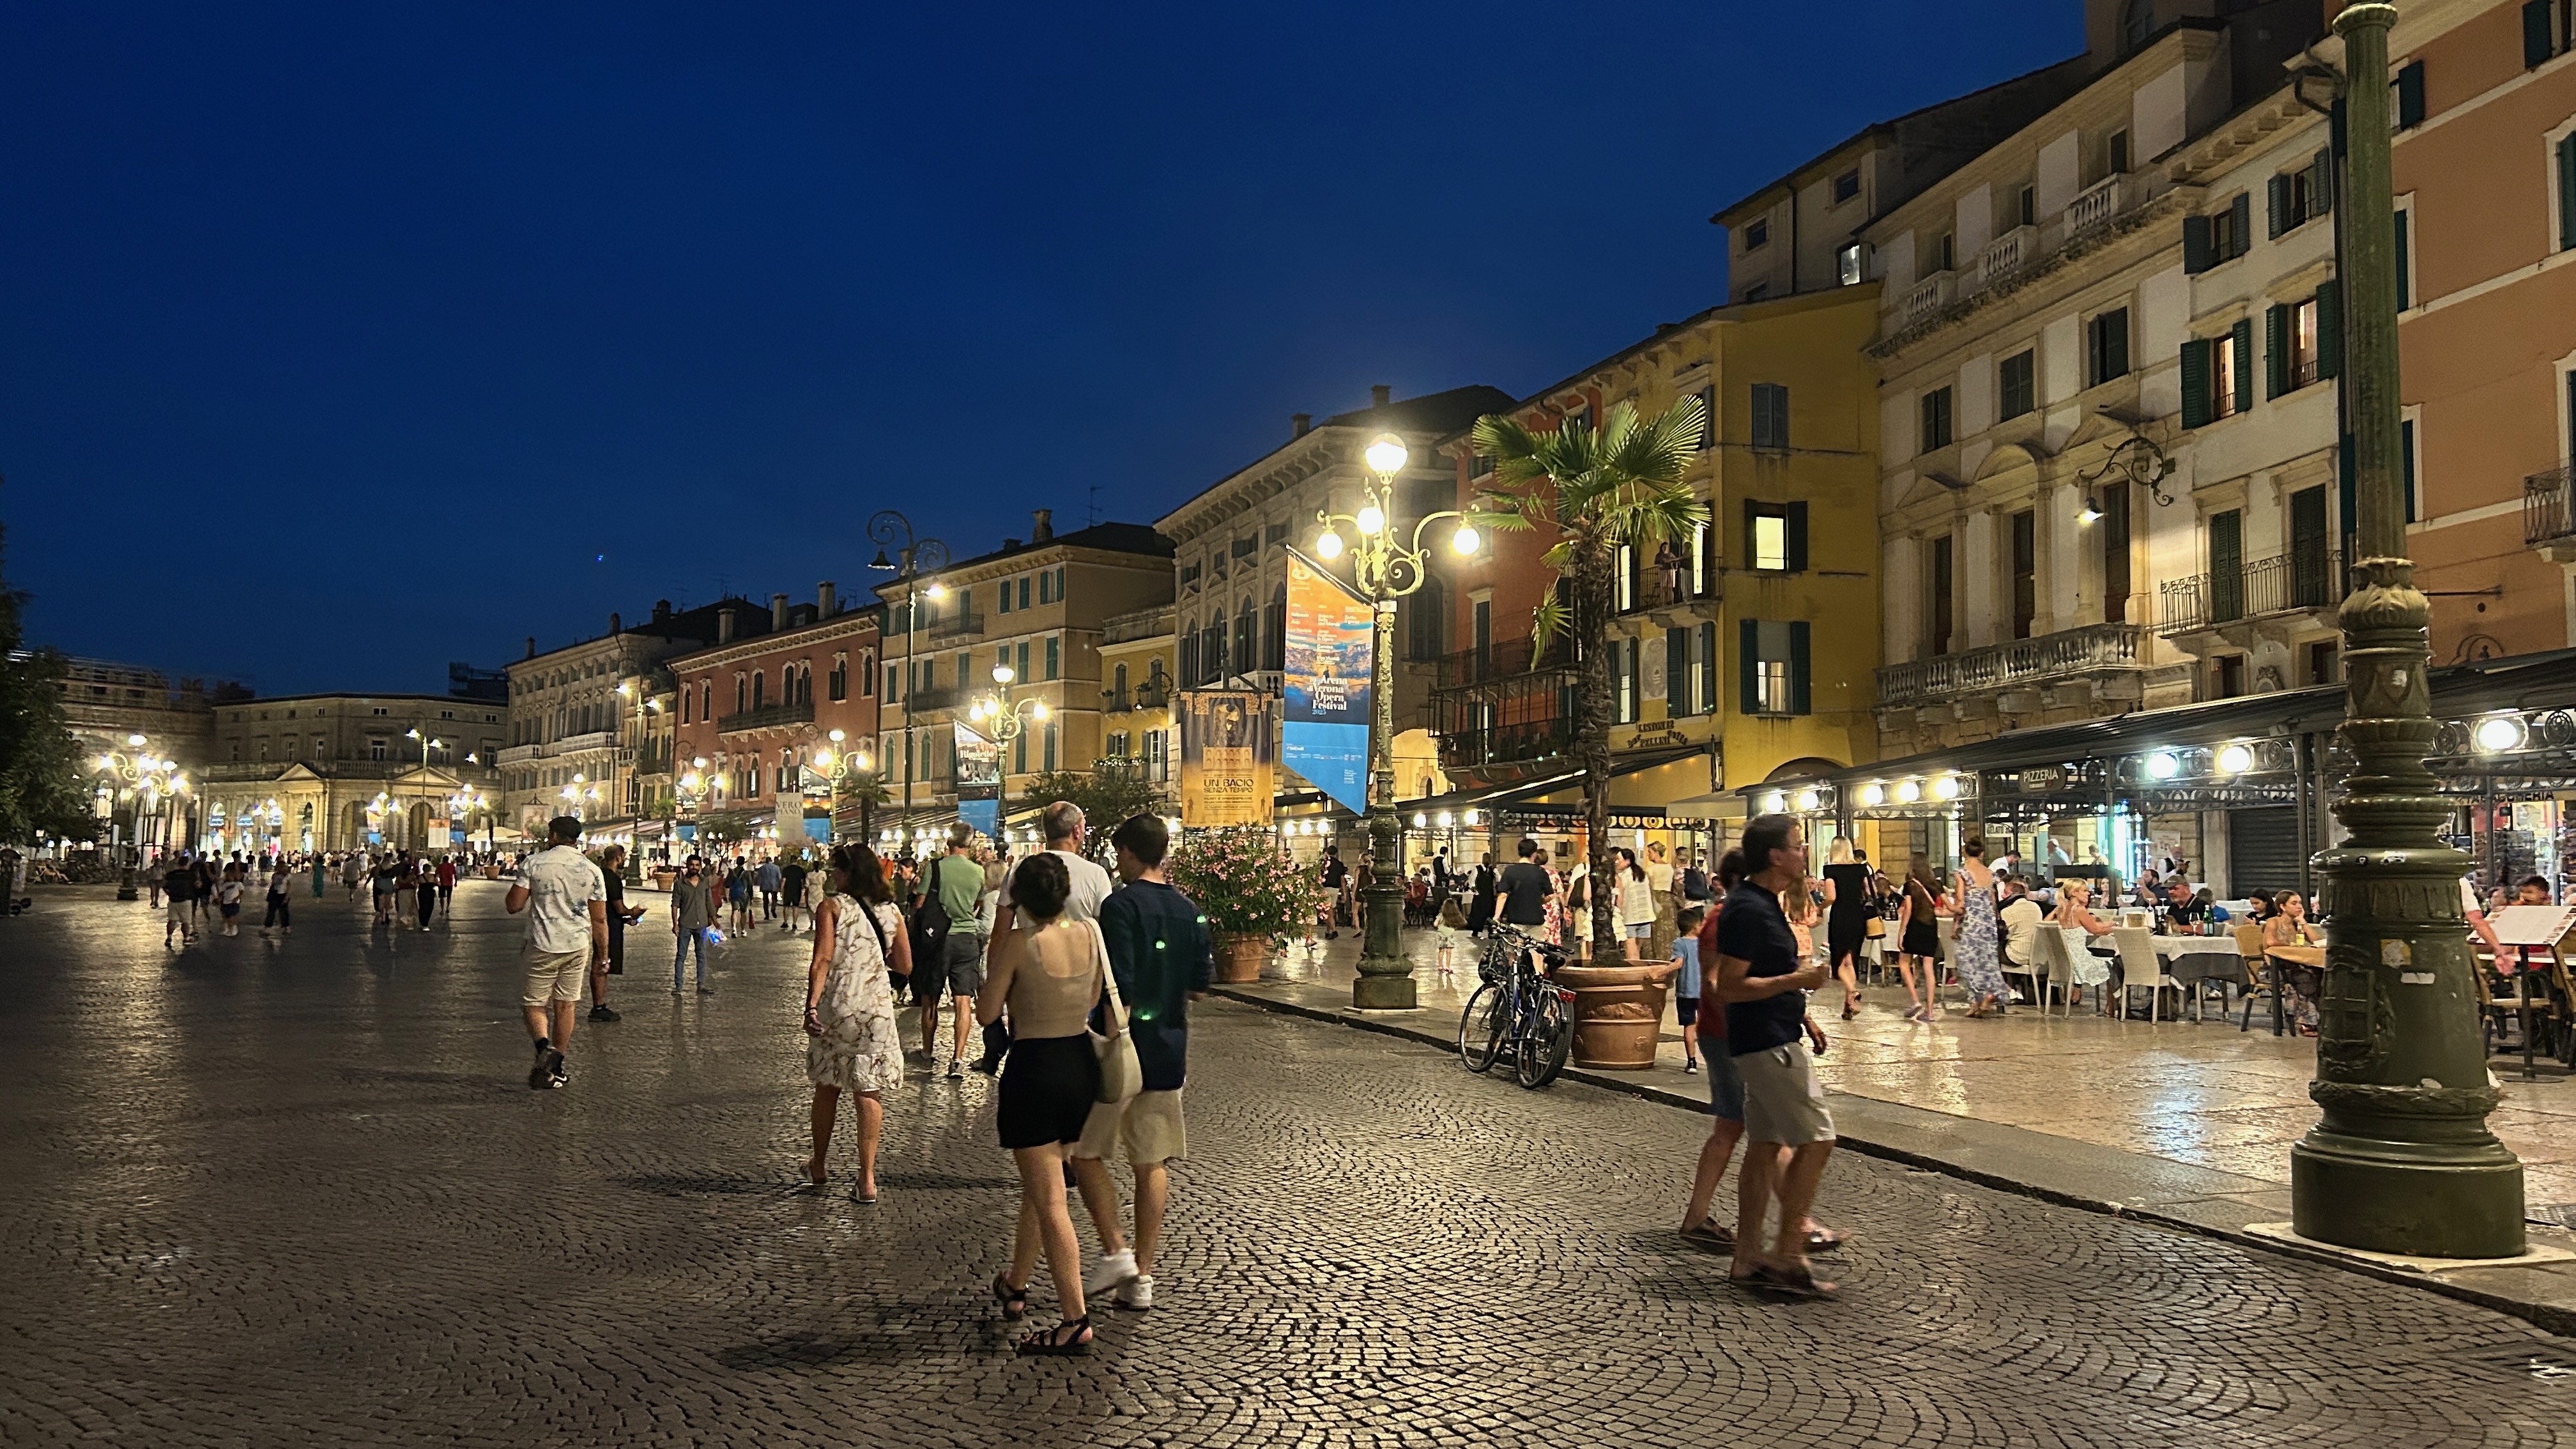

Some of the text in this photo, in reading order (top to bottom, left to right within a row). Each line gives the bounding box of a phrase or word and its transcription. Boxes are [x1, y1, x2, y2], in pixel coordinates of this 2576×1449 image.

[1321, 675, 1347, 685] Arena
[1313, 682, 1344, 693] Verona
[1315, 690, 1344, 703] Opera
[1312, 700, 1347, 710] Festival
[960, 749, 994, 760] Rigoletto
[2023, 769, 2058, 783] PIZZERIA
